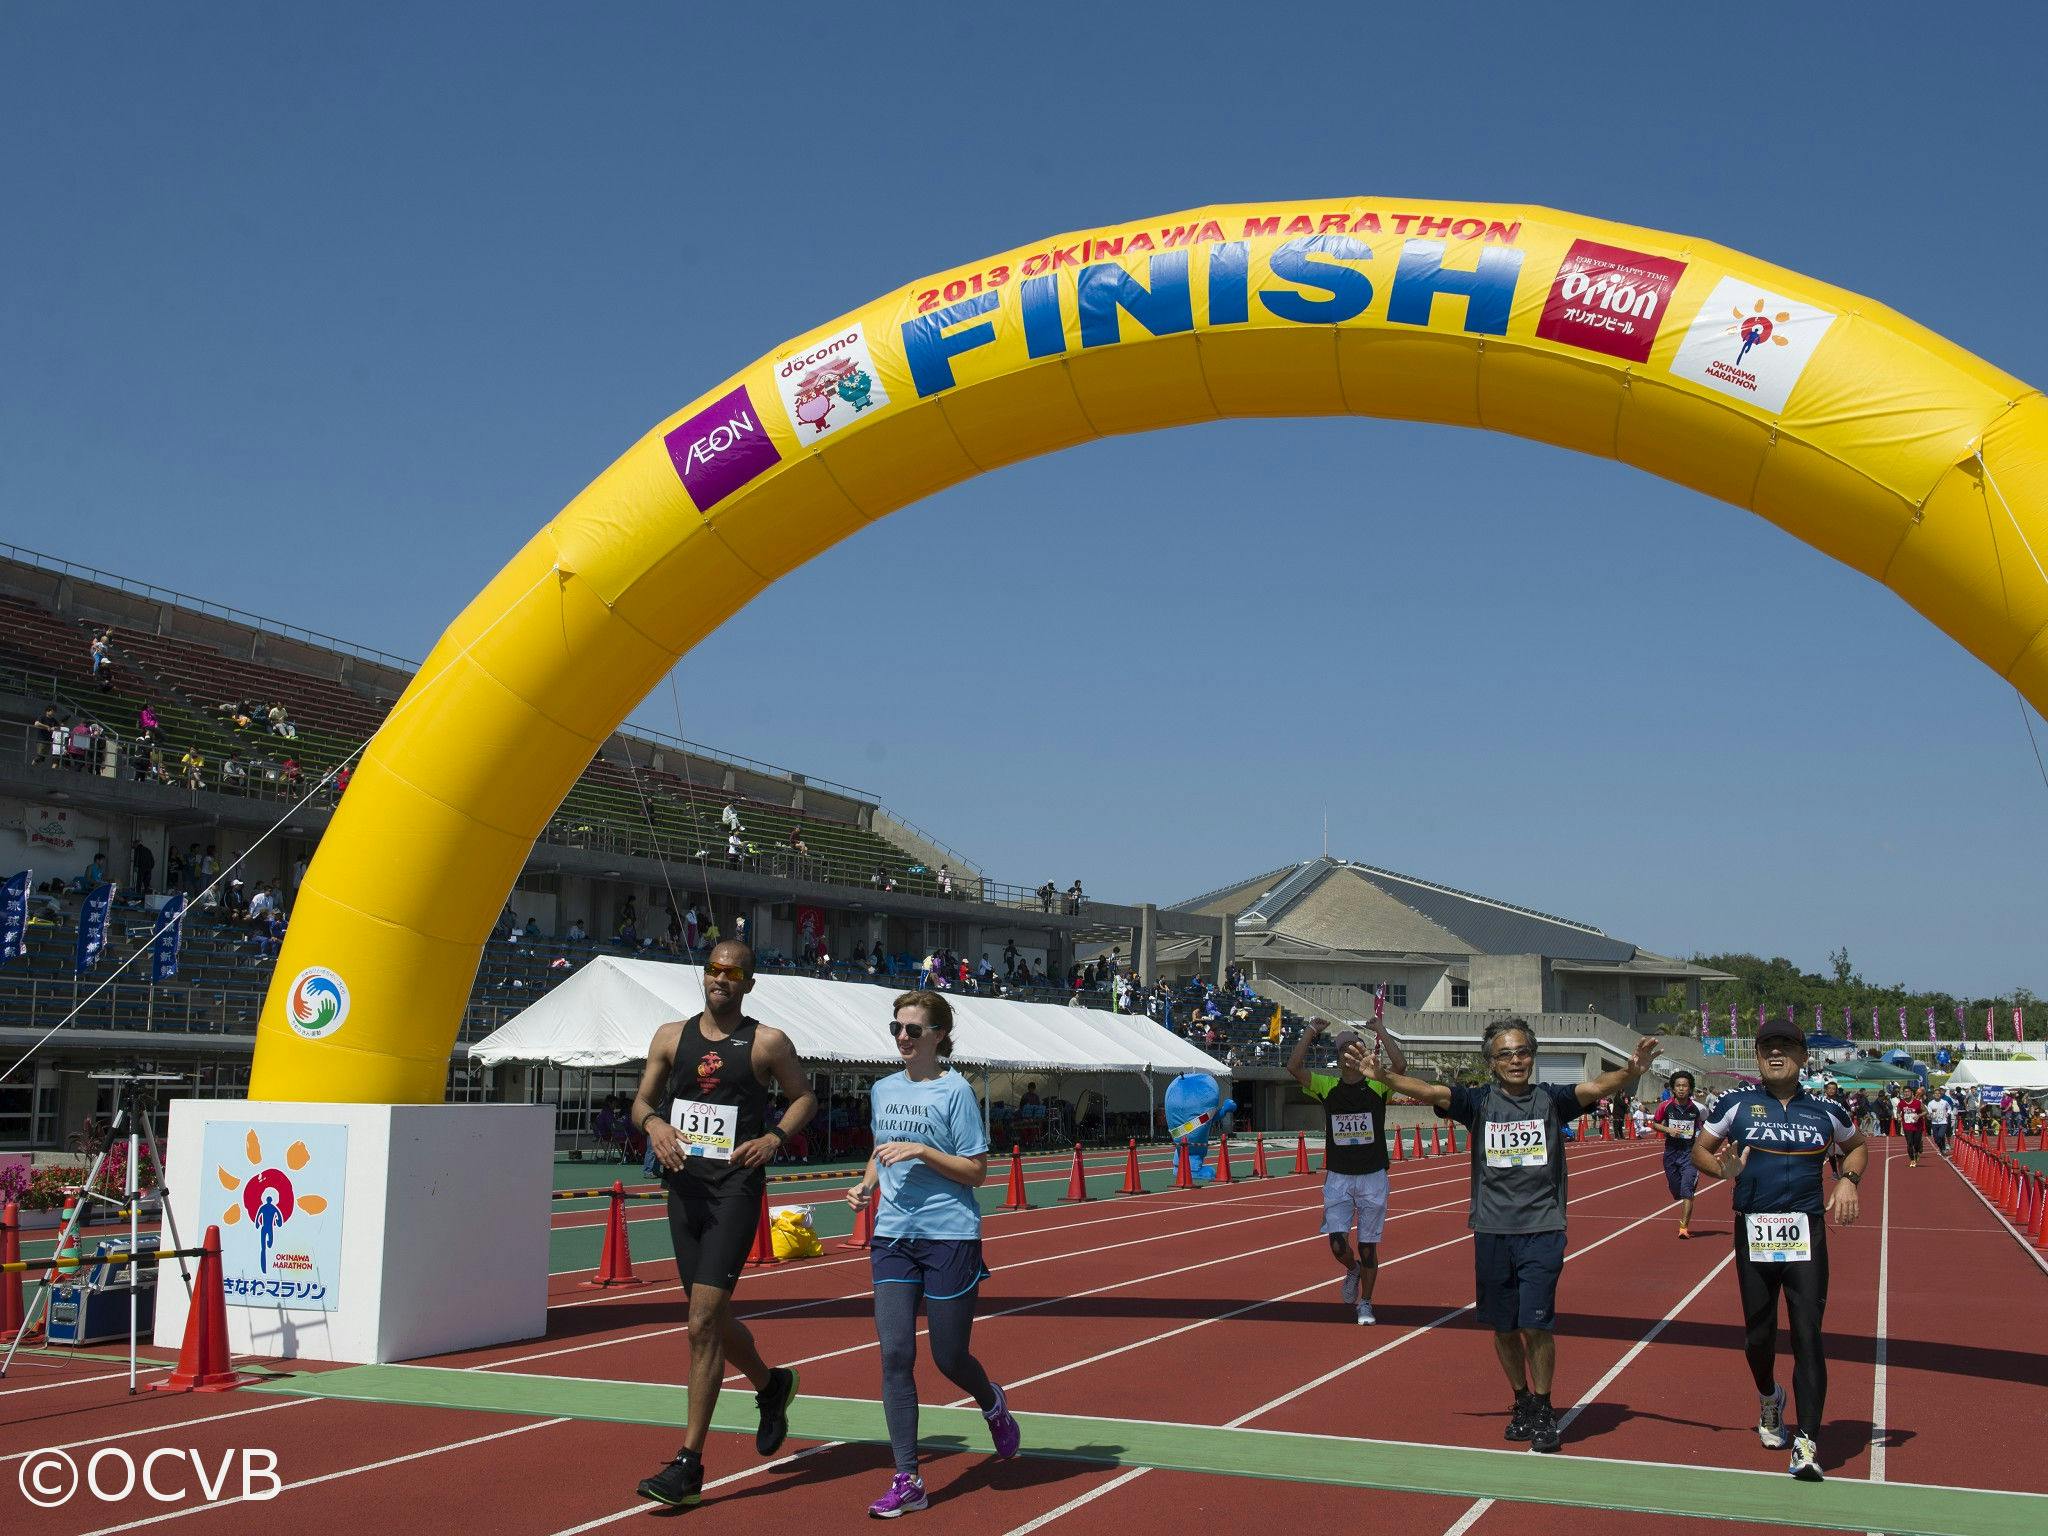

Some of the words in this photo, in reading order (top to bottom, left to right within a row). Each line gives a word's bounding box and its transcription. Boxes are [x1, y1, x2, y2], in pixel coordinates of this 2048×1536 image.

[917, 264, 1010, 314] 2013
[1021, 221, 1226, 278] OKINAWA
[1243, 212, 1523, 244] MARATHON
[1575, 255, 1593, 265] FOR
[1593, 258, 1616, 270] YOUR
[1616, 263, 1647, 277] HAPPY
[1647, 270, 1669, 282] TIME
[900, 234, 1525, 399] FINISH
[1563, 307, 1635, 335] オリオンビール
[780, 332, 859, 379] docomo
[1704, 366, 1758, 392] MARATHON
[1712, 360, 1757, 383] OKINAWA
[885, 1103, 930, 1118] OKINAWA
[1335, 1113, 1368, 1121] オリオンビール
[680, 1113, 725, 1136] 1312
[1337, 1121, 1368, 1132] 2416
[1490, 1121, 1538, 1132] オリオンビール
[1753, 1120, 1789, 1129] RACING
[1790, 1122, 1818, 1132] TEAM
[1490, 1131, 1543, 1148] 11392
[1744, 1127, 1825, 1146] ZANPA
[1487, 1147, 1539, 1155] おきなわマラソン
[1756, 1215, 1794, 1224] docomo
[1755, 1225, 1801, 1242] 3140
[272, 1261, 313, 1271] MARATHON
[275, 1253, 310, 1262] OKINAWA
[223, 1278, 326, 1300] きなわマラソン
